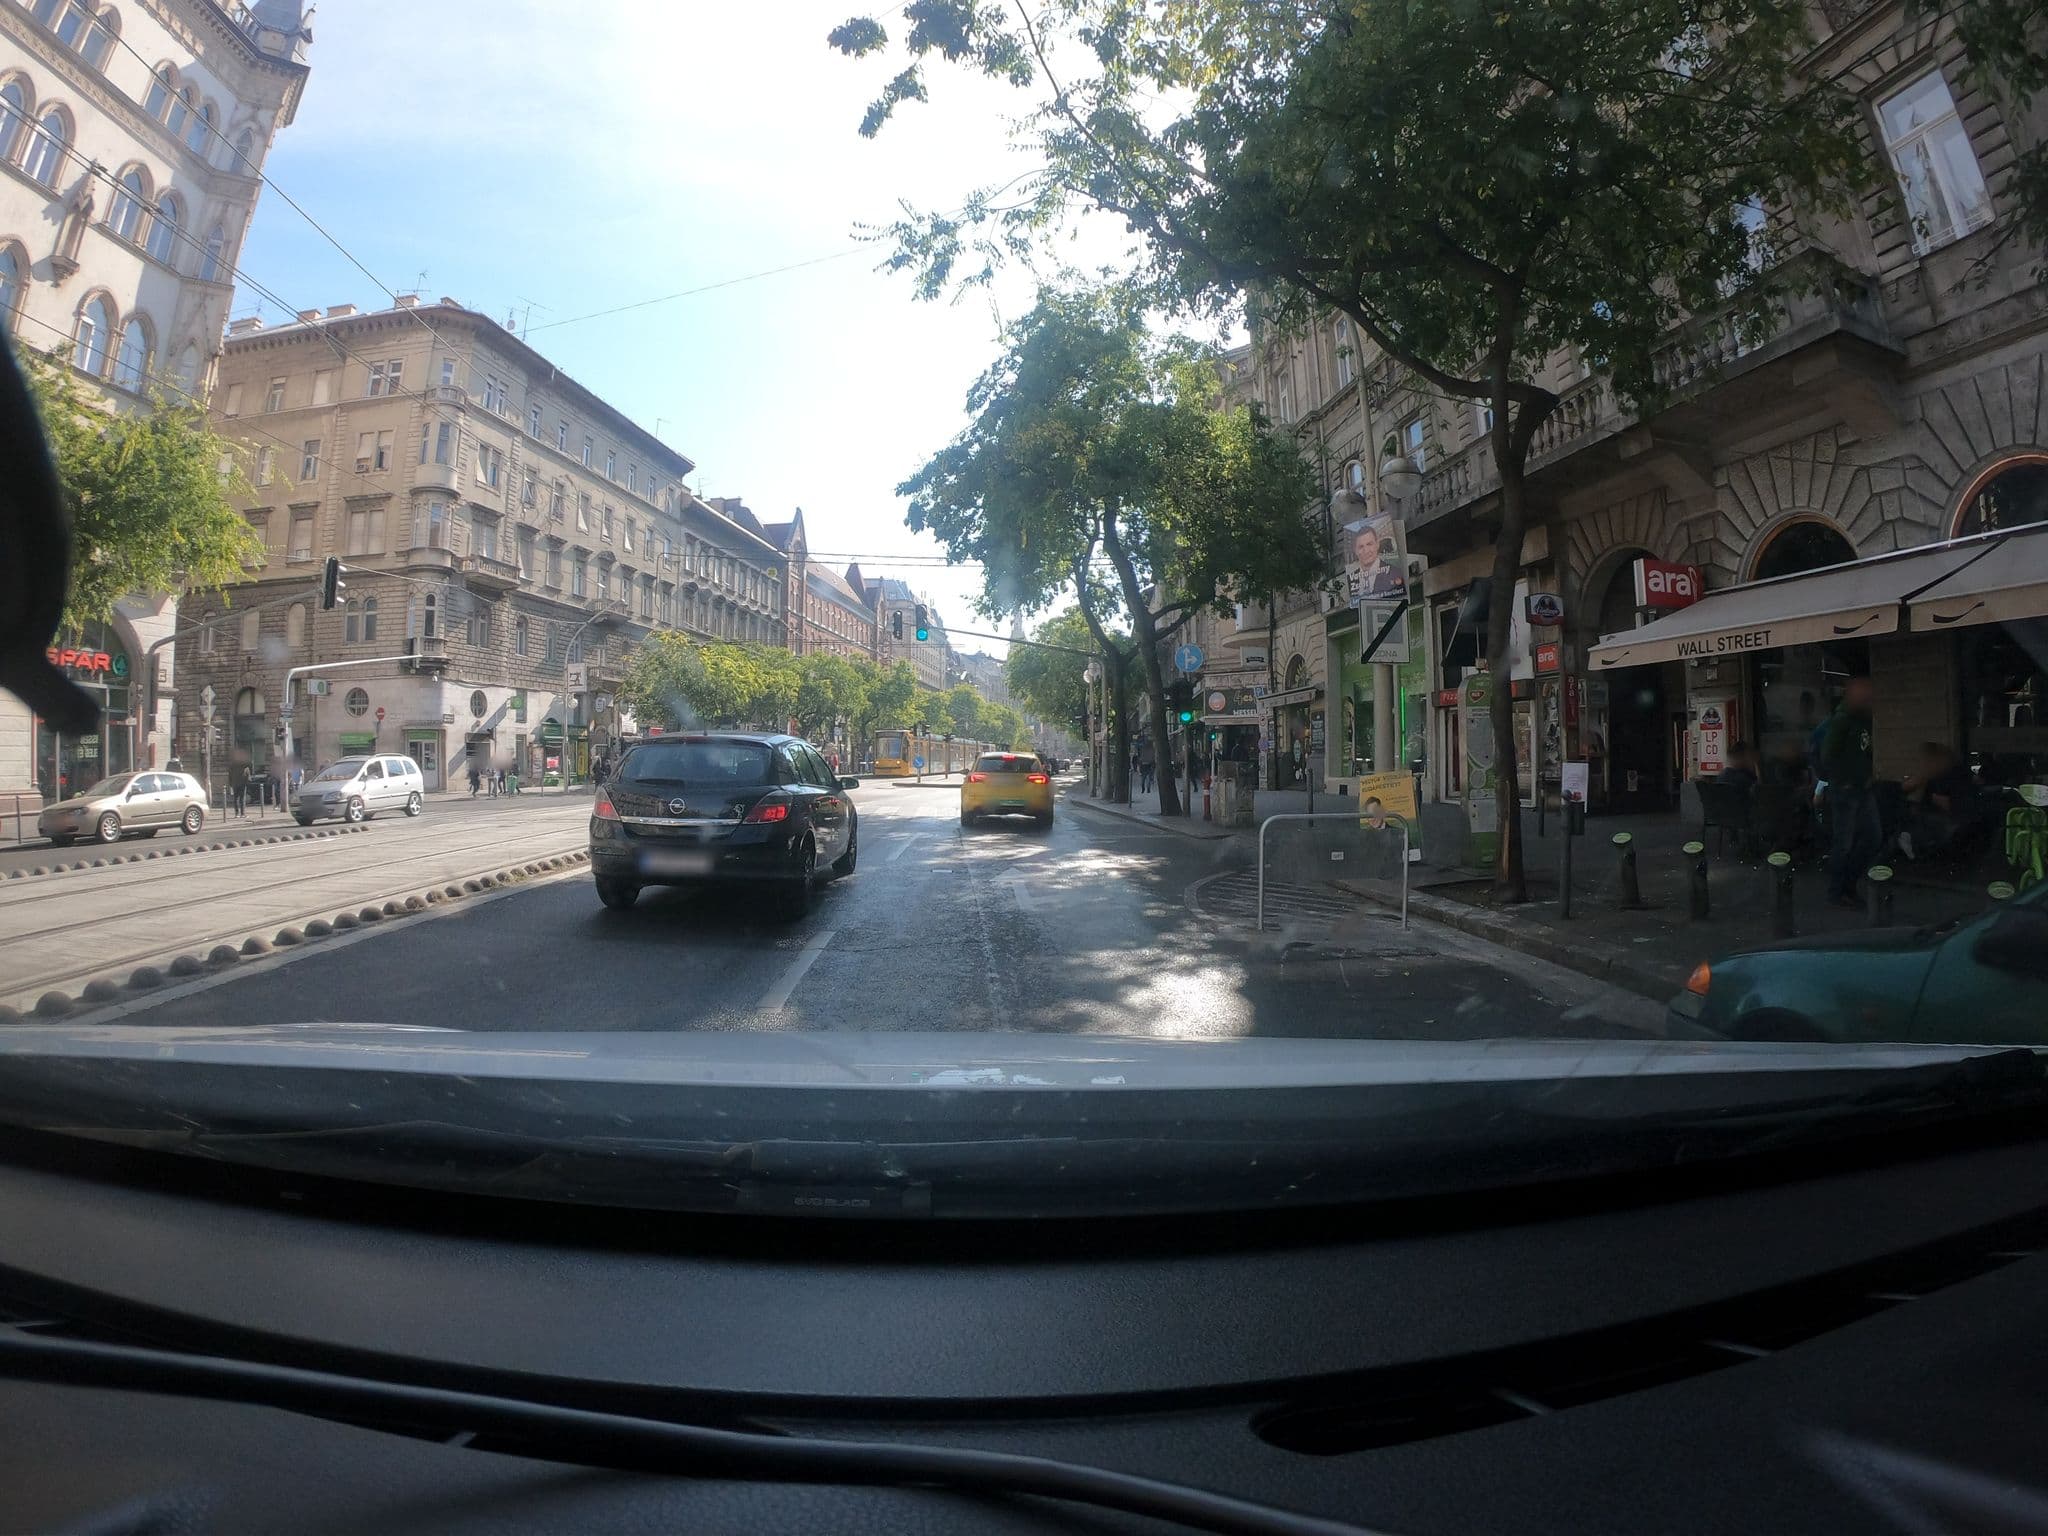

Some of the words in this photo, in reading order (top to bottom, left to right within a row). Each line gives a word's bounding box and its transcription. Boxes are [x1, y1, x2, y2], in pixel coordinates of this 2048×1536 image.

[1648, 569, 1692, 596] ara
[1677, 639, 1714, 656] WALL
[1717, 630, 1771, 651] STREET
[1537, 651, 1554, 663] ara
[1706, 732, 1717, 742] LP
[1706, 745, 1718, 755] CD
